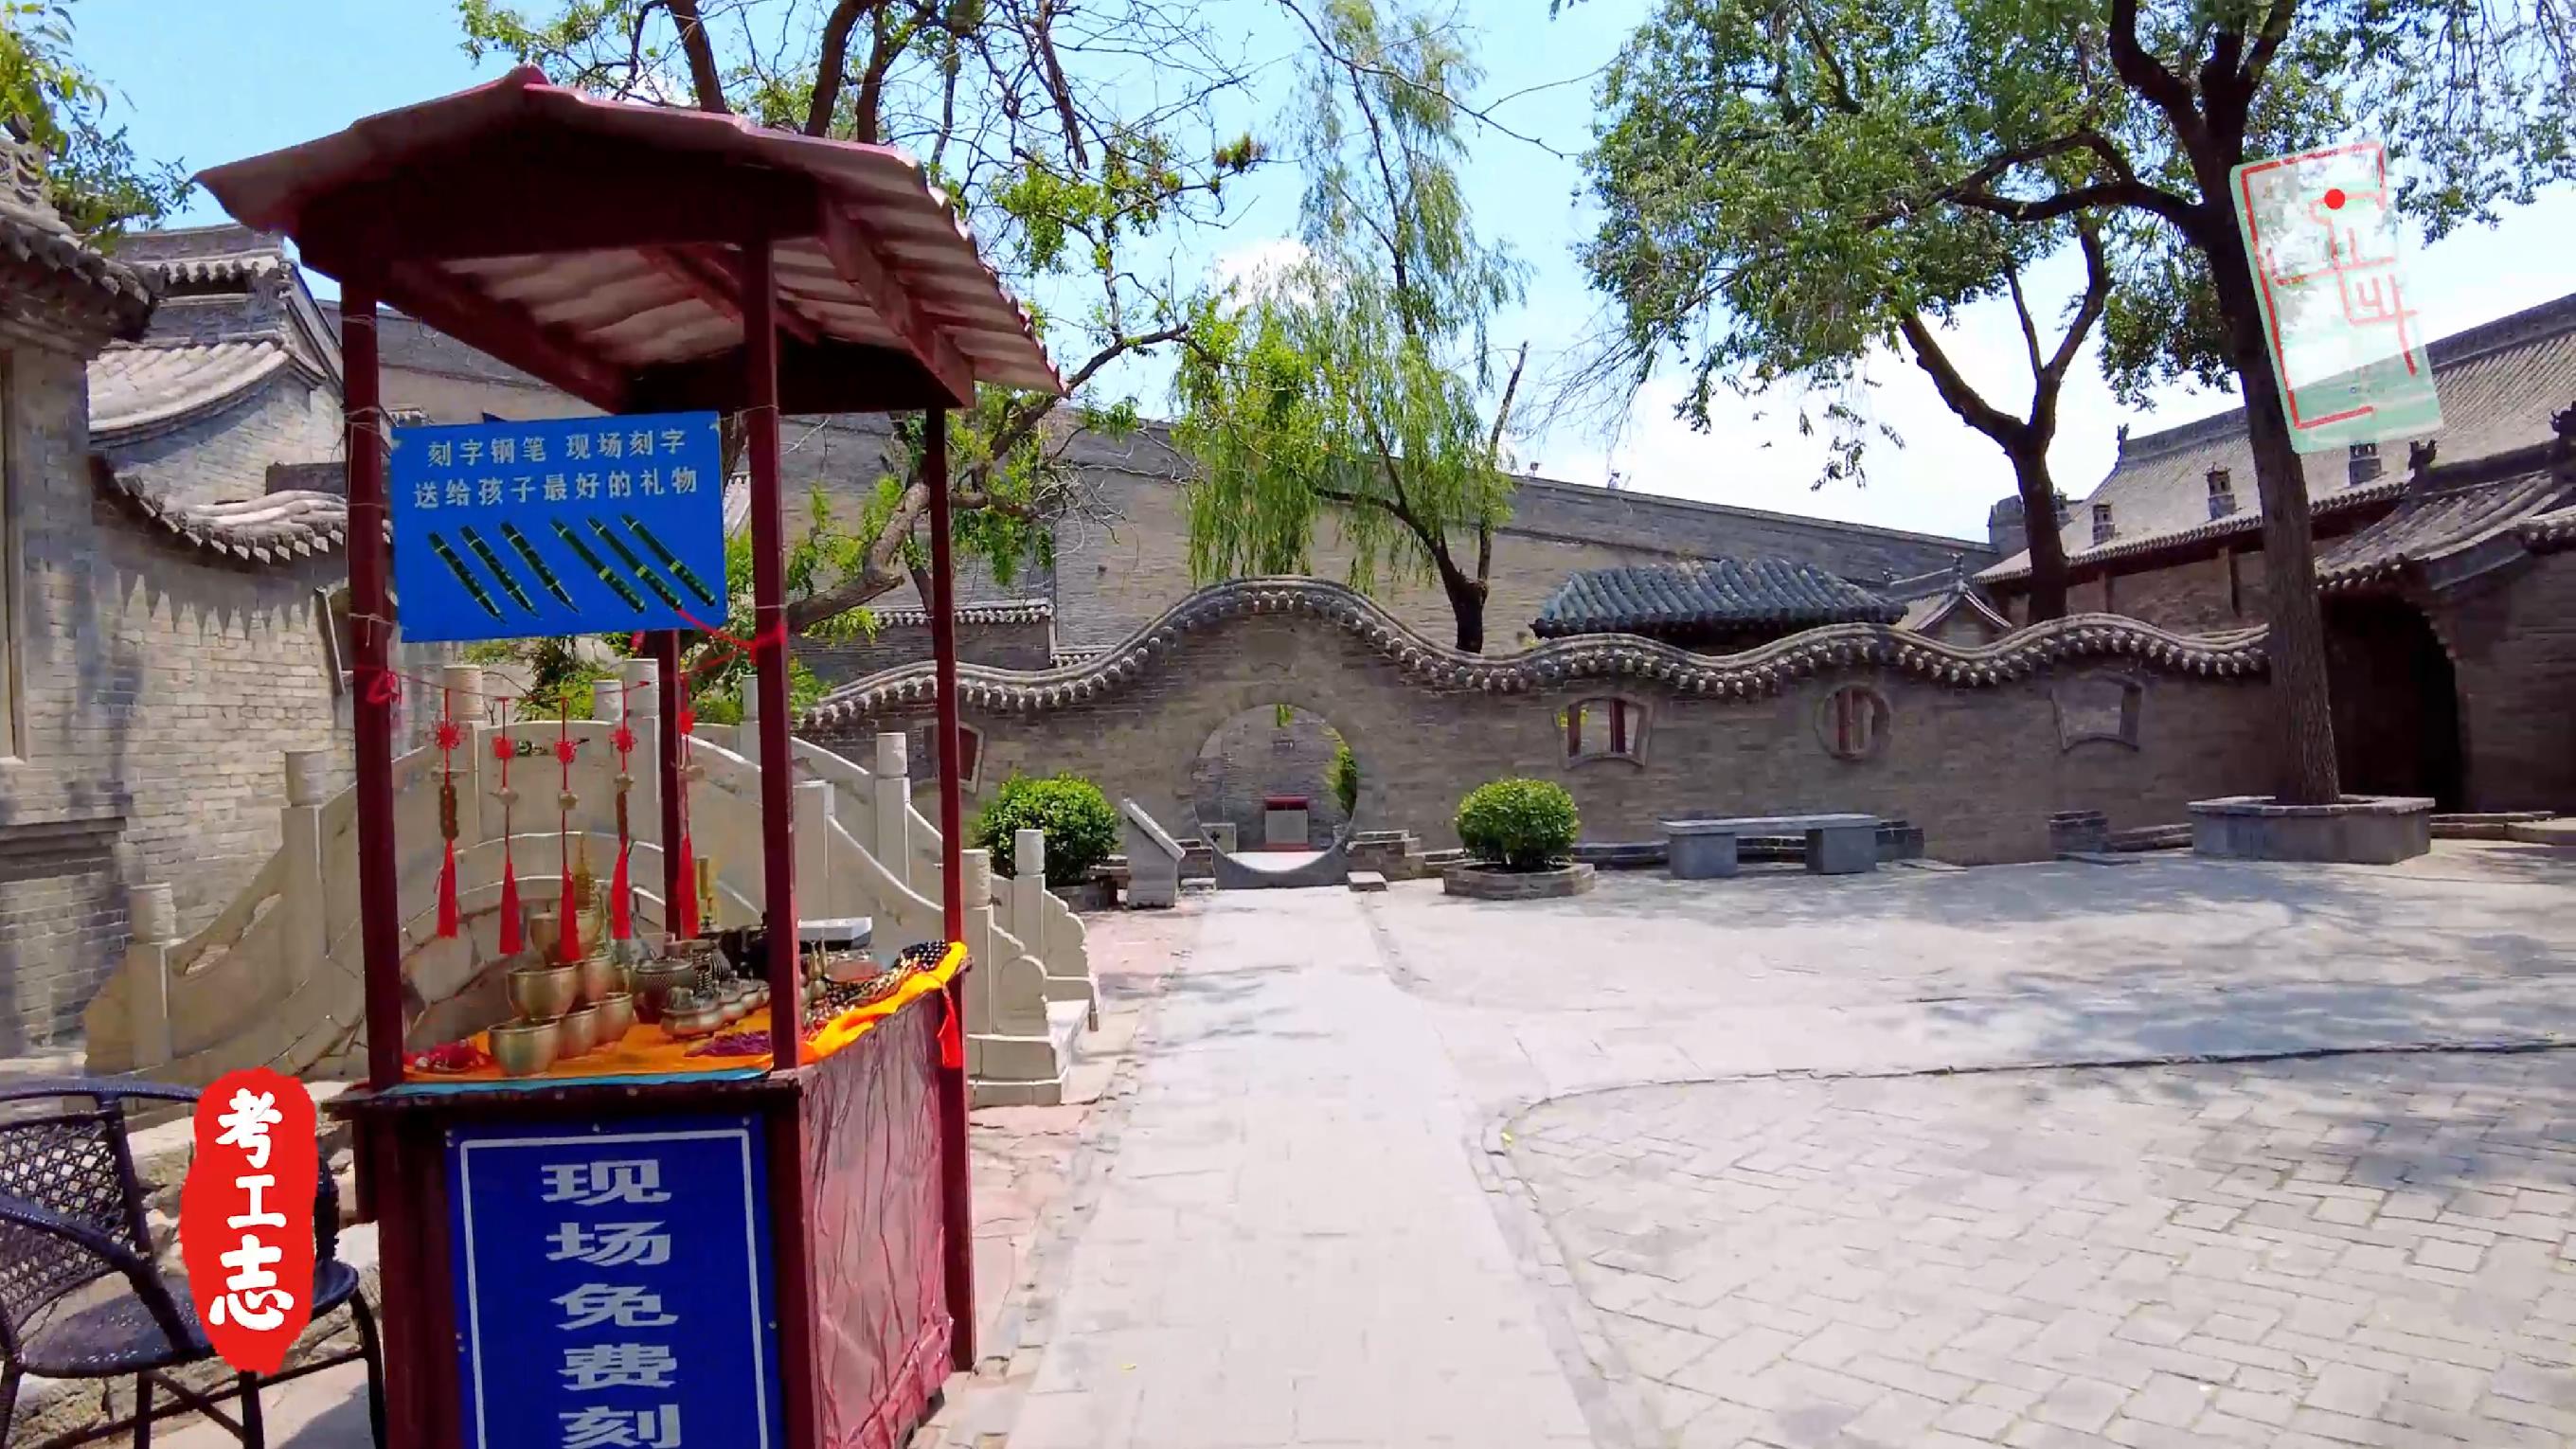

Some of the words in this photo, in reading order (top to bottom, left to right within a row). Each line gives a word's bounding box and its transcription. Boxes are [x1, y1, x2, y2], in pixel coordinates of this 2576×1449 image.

[427, 437, 546, 467] 刻字钢笔
[566, 428, 686, 460] 现场刻字
[413, 467, 697, 509] 送给孩子最好的礼物
[541, 1158, 682, 1449] 现场免费刻
